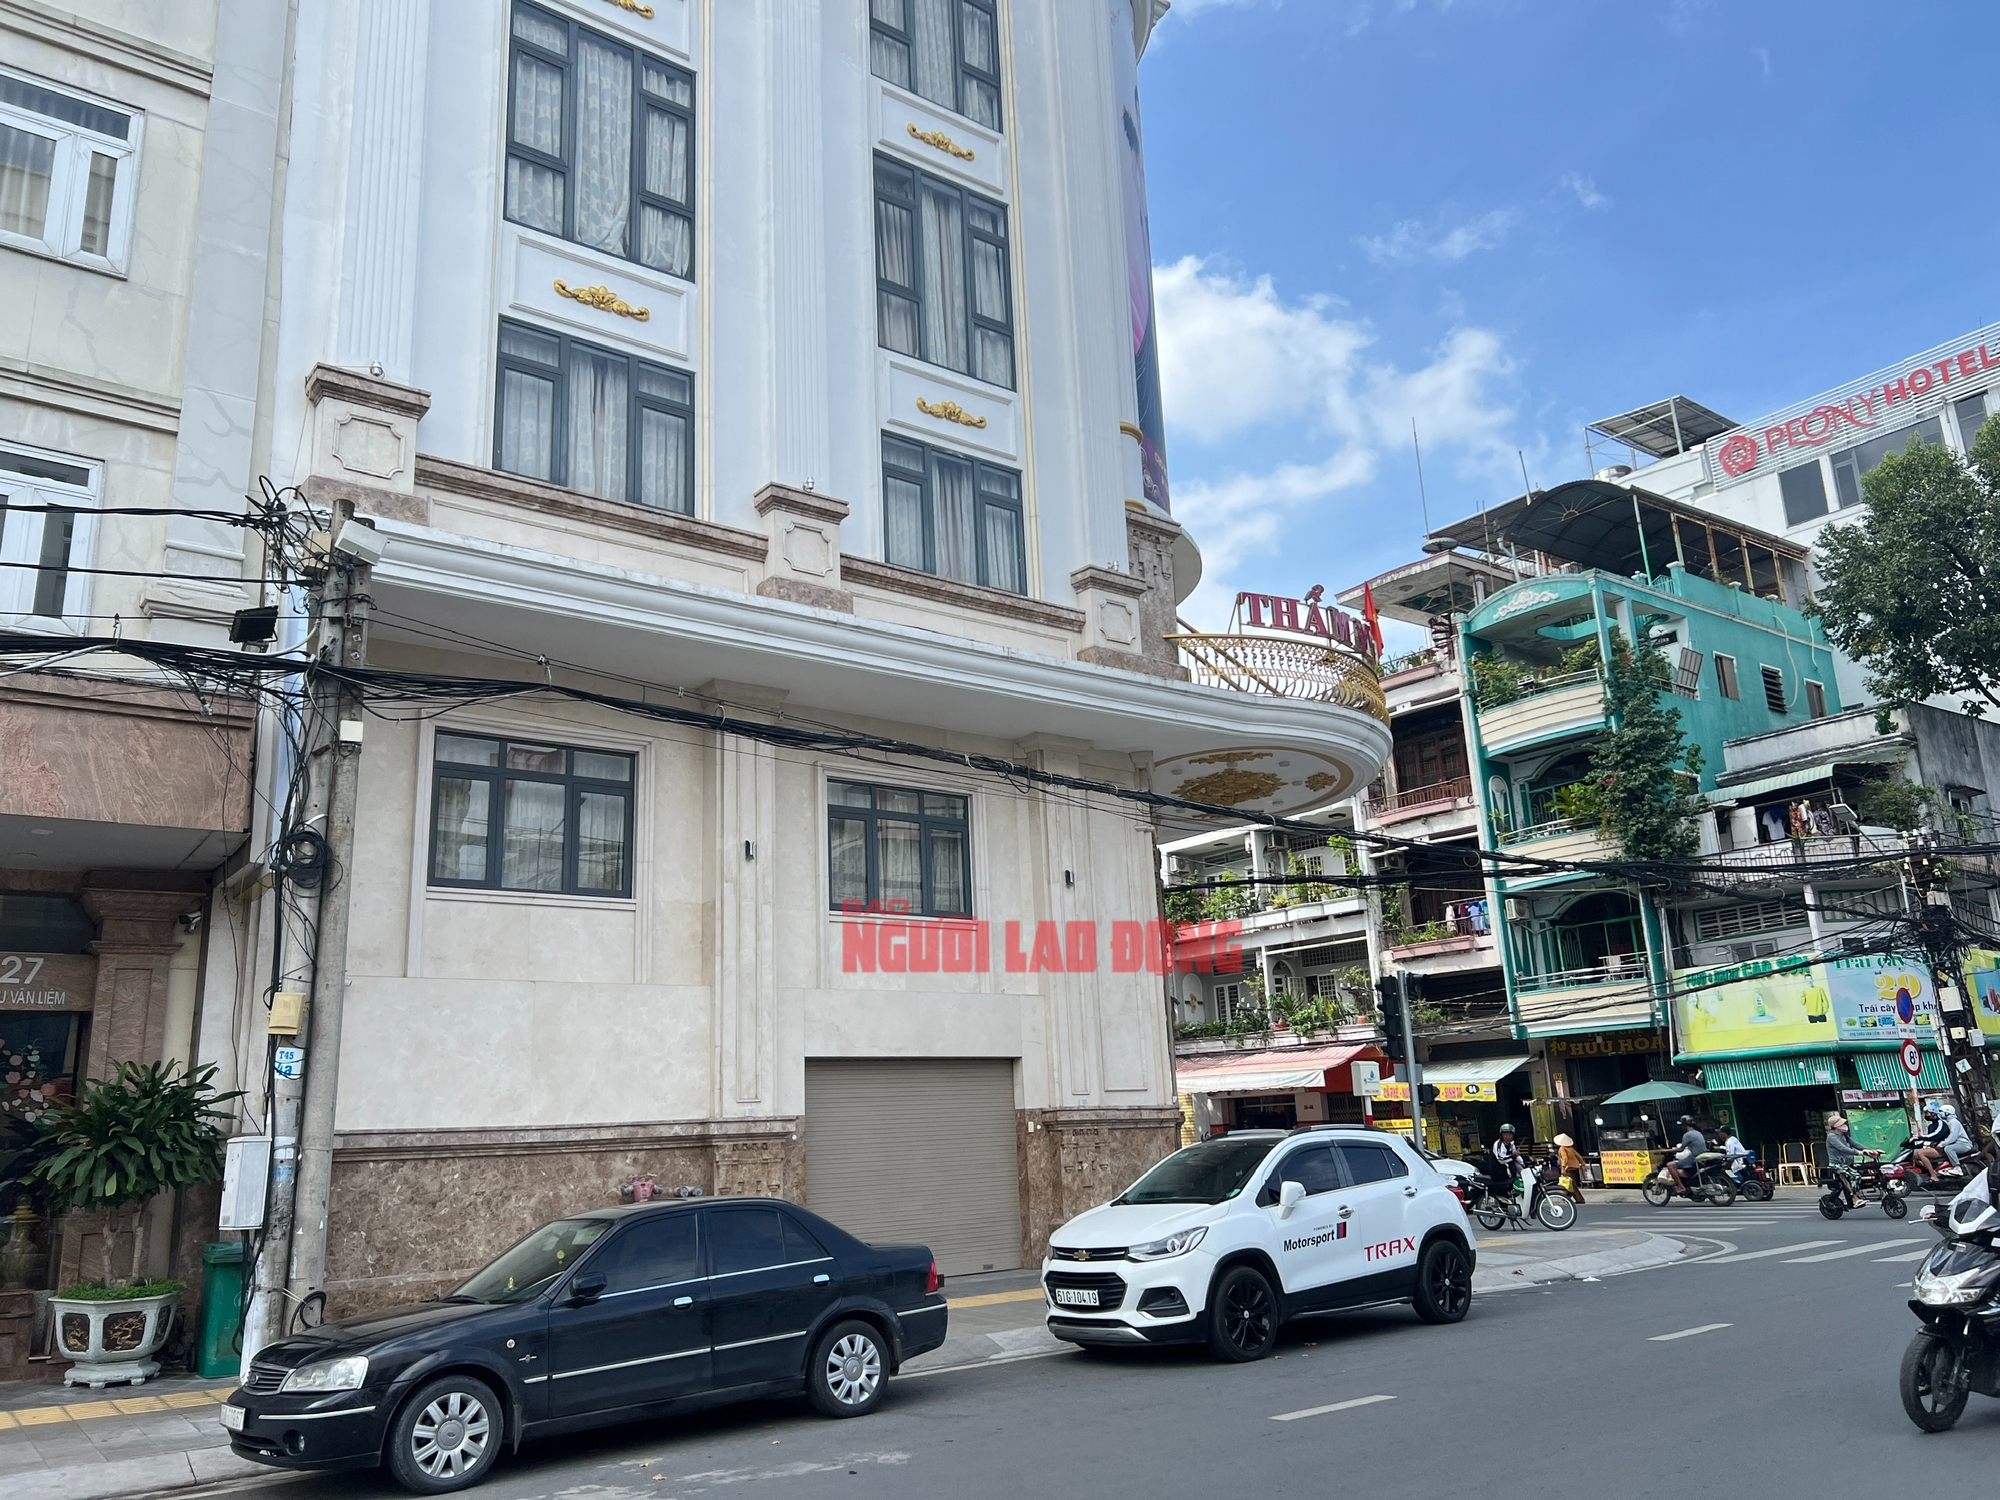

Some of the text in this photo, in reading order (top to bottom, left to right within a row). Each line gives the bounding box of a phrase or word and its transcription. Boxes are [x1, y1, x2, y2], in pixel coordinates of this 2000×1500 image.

[1764, 344, 2000, 454] PEONY HOTEL
[0, 955, 44, 985] 27
[10, 987, 35, 1004] VĂN
[38, 987, 66, 1004] LIÊM
[1858, 1003, 1878, 1013] Trái
[1880, 1003, 1896, 1014] cây
[279, 1051, 295, 1060] T45
[1283, 1229, 1335, 1252] Motorsport
[1363, 1235, 1416, 1262] TRAX
